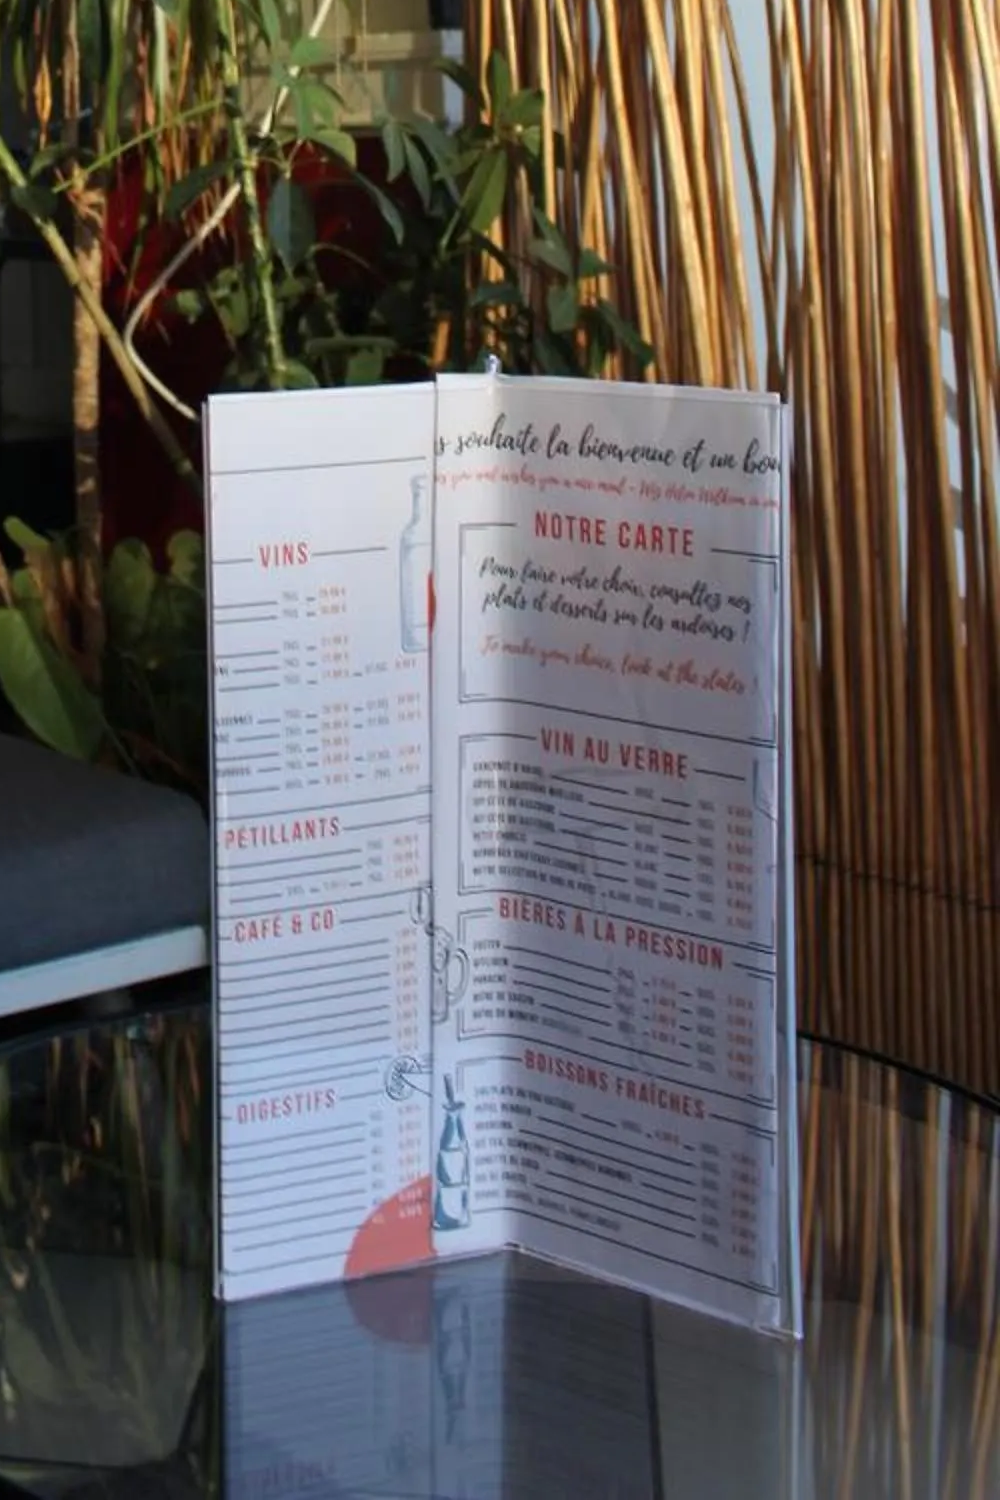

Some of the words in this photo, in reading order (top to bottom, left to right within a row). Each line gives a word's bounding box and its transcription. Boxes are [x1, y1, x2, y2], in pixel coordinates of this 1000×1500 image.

[454, 411, 540, 456] souhaite
[546, 423, 571, 459] la
[578, 423, 676, 467] bienvenue
[682, 438, 706, 473] et
[710, 452, 737, 469] un
[258, 541, 310, 569] VINS
[534, 511, 607, 547] NOTRE
[618, 523, 695, 557] CARTE
[479, 556, 518, 579] Pour
[520, 557, 557, 583] faire
[561, 566, 598, 590] votre
[649, 579, 722, 613] consultez
[481, 583, 527, 613] plats
[532, 589, 548, 613] et
[549, 593, 607, 623] desserts
[642, 602, 664, 632] les
[670, 614, 734, 642] ardoises
[541, 727, 574, 757] VIN
[584, 735, 610, 765] AU
[619, 743, 689, 779] VERRE
[233, 915, 283, 944] CAFÉ
[291, 914, 303, 935] &
[310, 908, 335, 932] CO
[593, 918, 616, 944] LA
[625, 926, 724, 972] PRESSION
[524, 1049, 609, 1093] BOISSONS
[236, 1088, 336, 1125] DIGESTIFS
